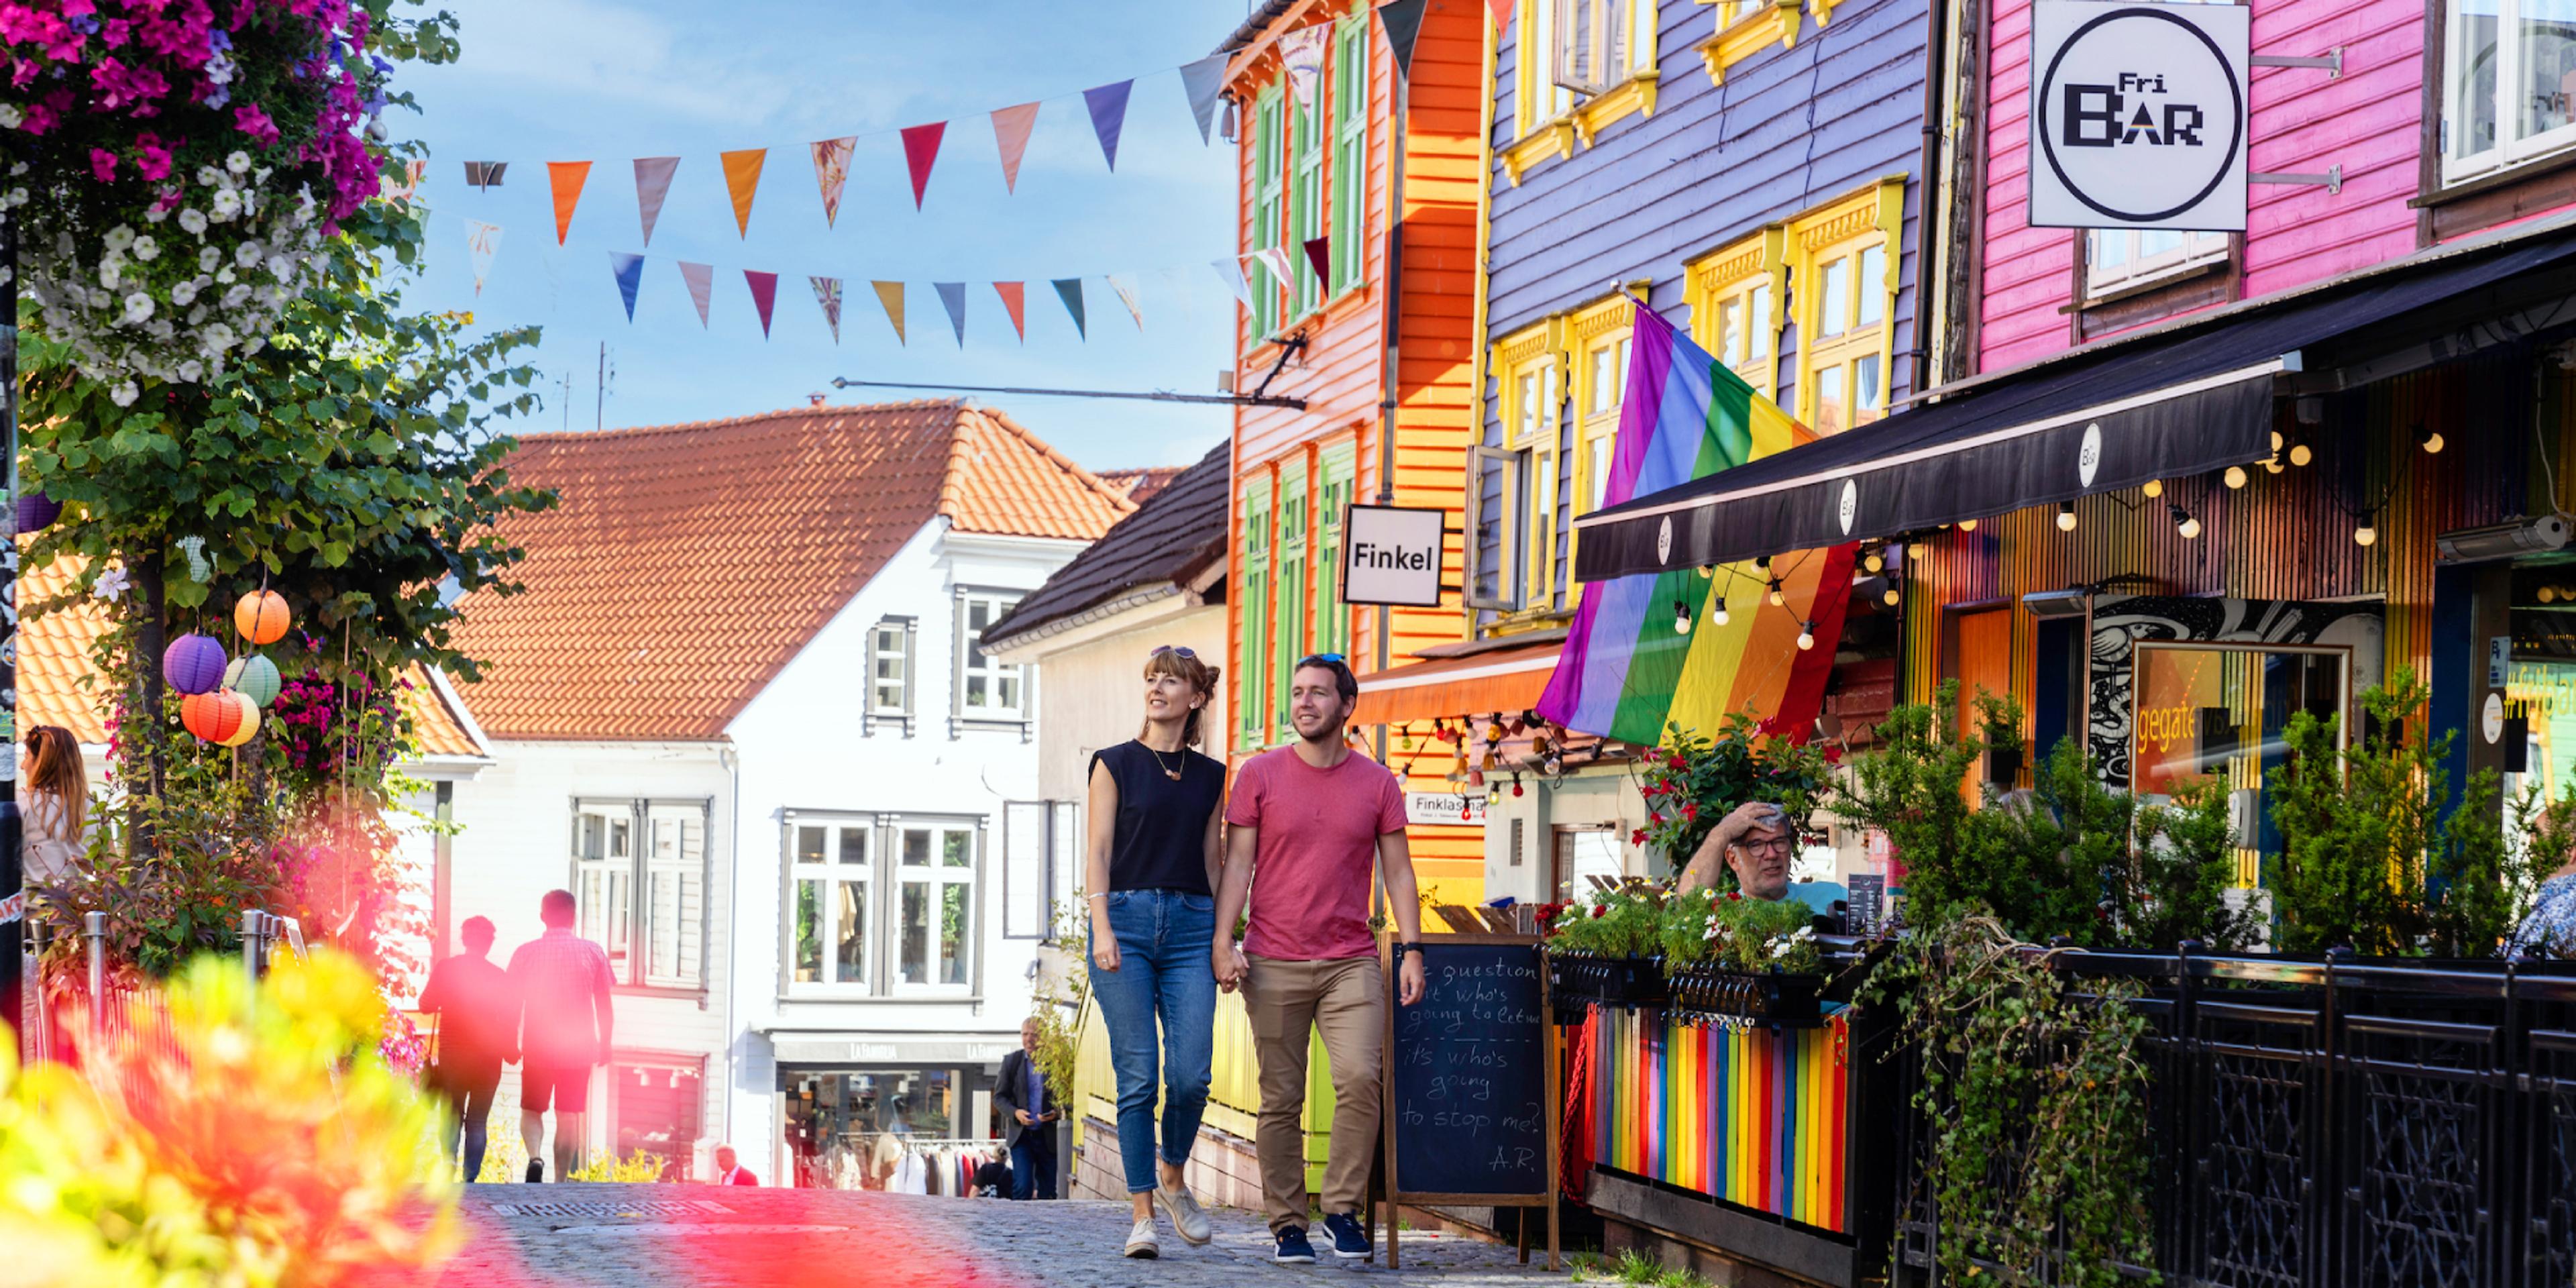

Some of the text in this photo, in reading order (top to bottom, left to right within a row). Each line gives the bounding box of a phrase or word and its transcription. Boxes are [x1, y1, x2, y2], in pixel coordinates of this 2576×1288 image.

[2118, 72, 2167, 93] Fri
[2063, 84, 2203, 148] BAR
[1354, 542, 1432, 571] Finkel
[1443, 957, 1537, 985] question
[1456, 981, 1507, 1002] who's
[1404, 1009, 1464, 1033] going
[1472, 1004, 1491, 1019] to
[1404, 1043, 1507, 1067] it's who's
[1426, 1073, 1491, 1100] going
[1402, 1099, 1540, 1137] to stop me?
